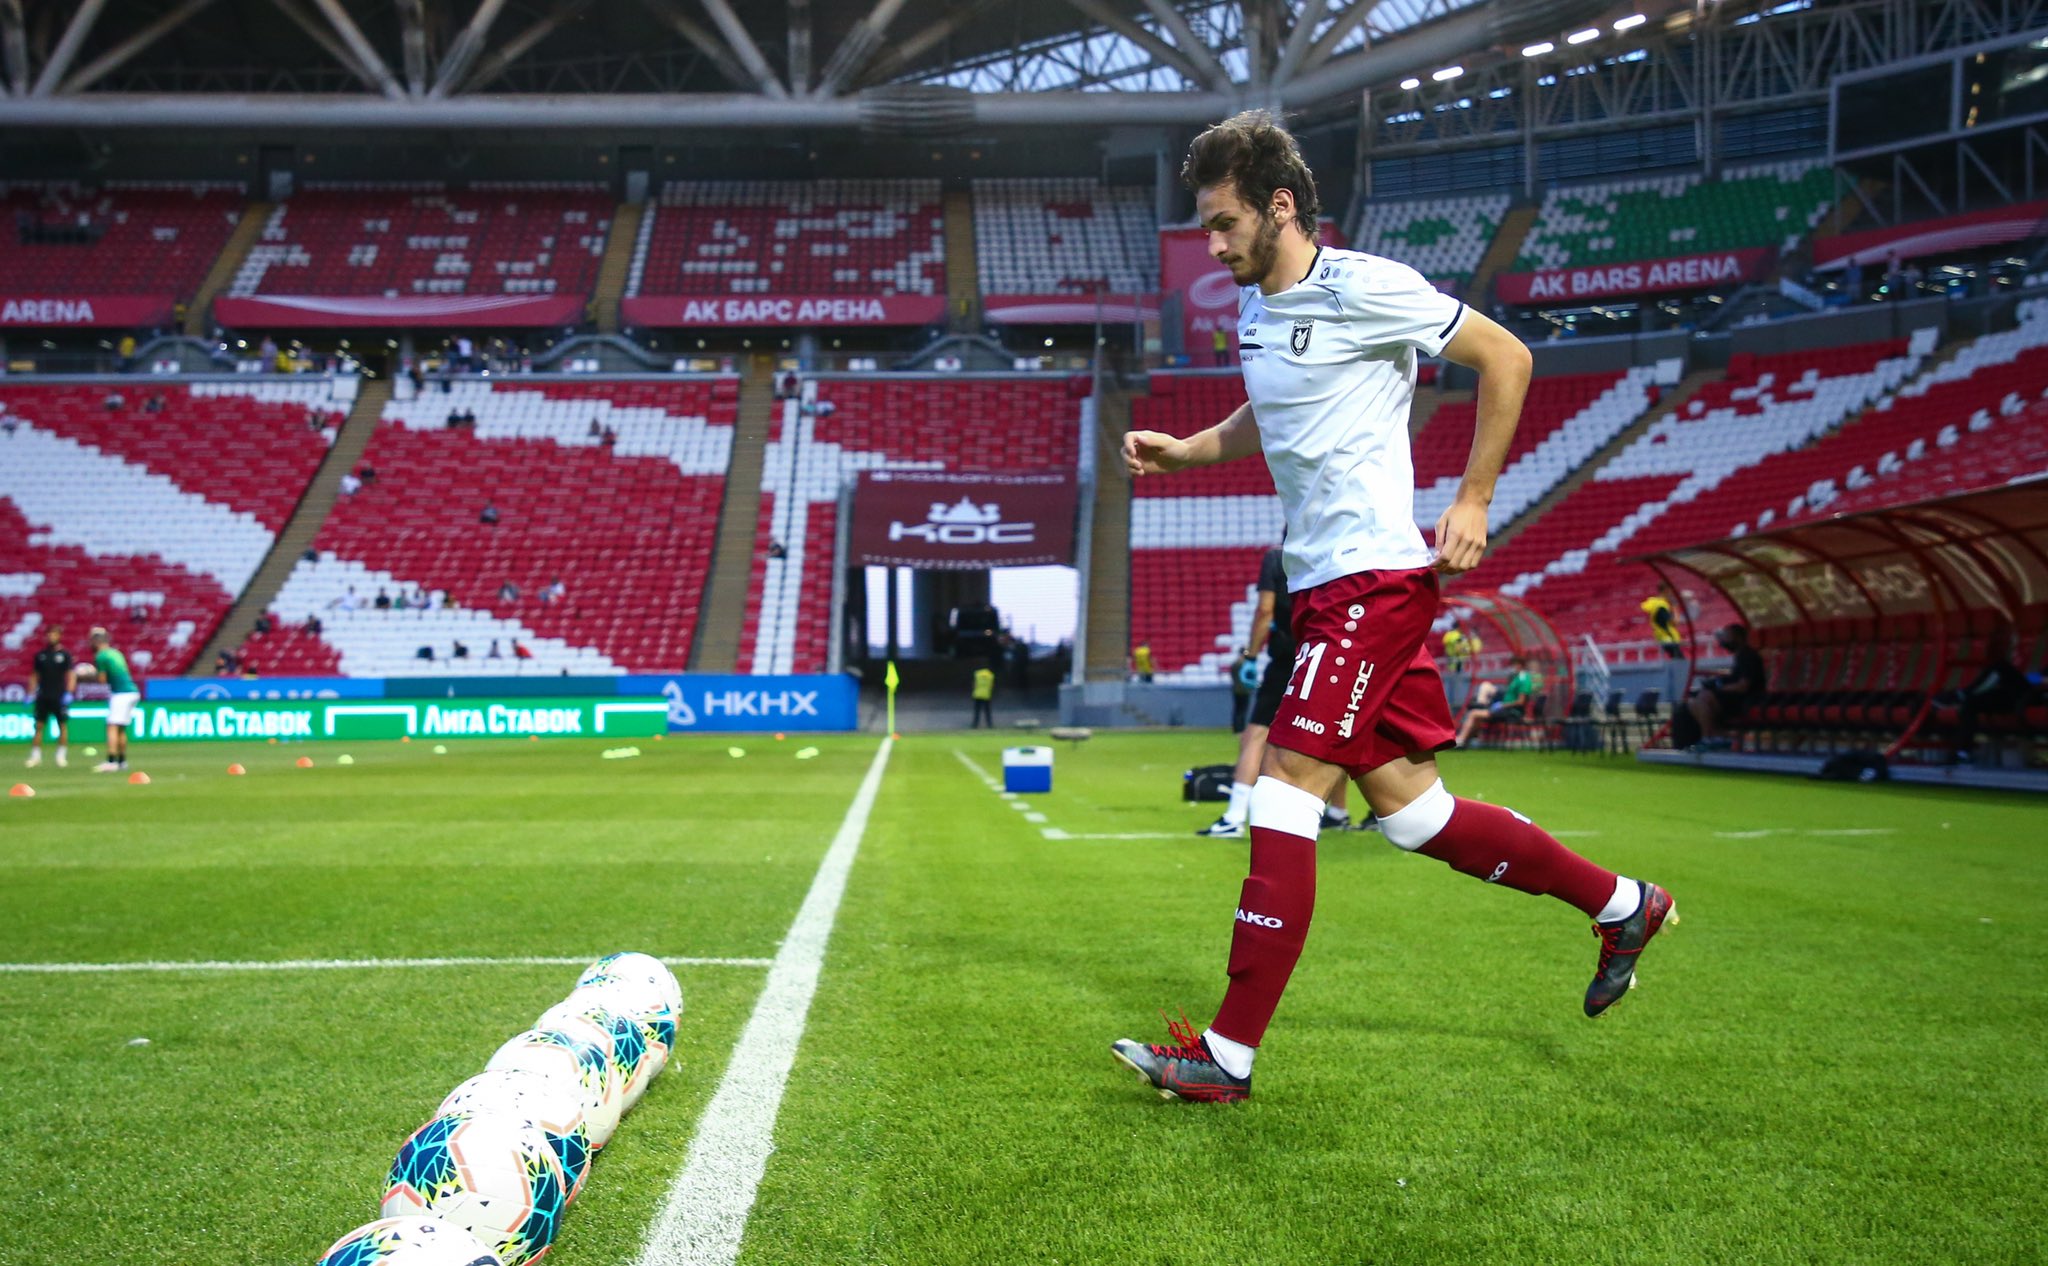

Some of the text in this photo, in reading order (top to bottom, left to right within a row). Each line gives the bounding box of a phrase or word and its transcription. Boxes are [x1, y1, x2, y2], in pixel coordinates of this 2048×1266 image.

[1529, 256, 1740, 298] AK BARS ARENA
[1, 299, 94, 322] ARENA
[683, 299, 885, 322] АК БАРС АРЕНА
[1291, 715, 1325, 735] JAKO
[1235, 908, 1283, 928] AKO
